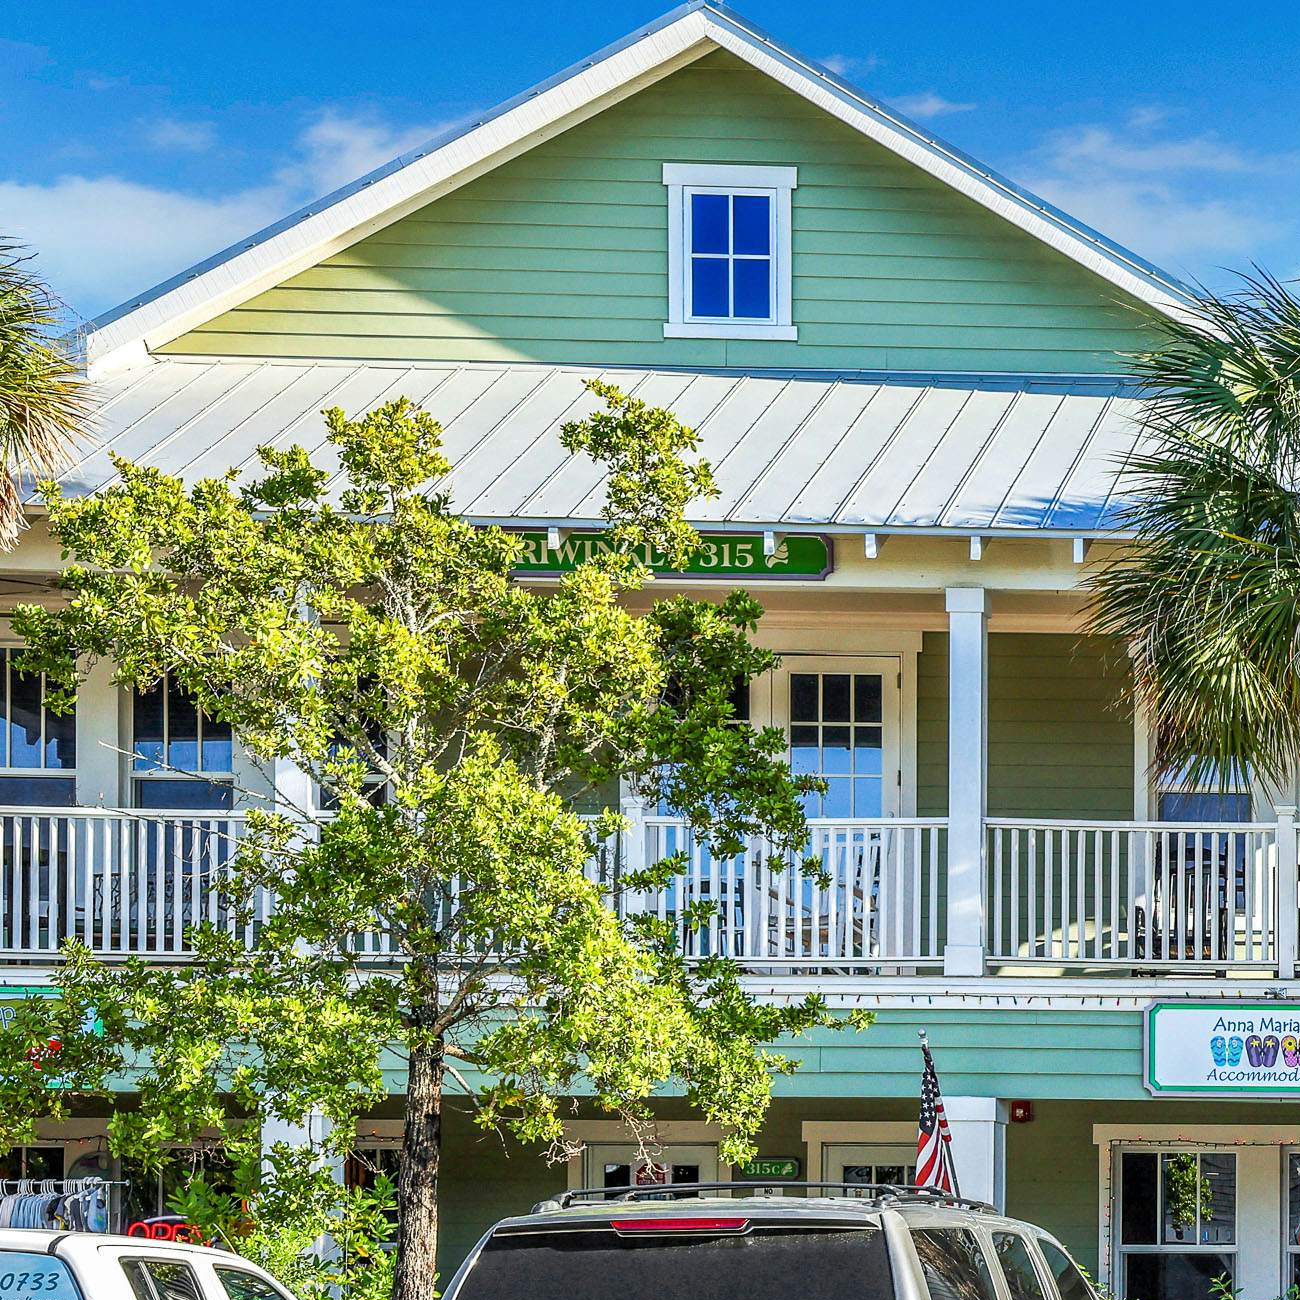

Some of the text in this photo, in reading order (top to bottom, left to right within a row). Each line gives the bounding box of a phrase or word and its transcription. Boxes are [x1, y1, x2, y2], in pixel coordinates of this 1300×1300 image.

[699, 543, 754, 568] 315
[1212, 1016, 1254, 1033] Anna
[1259, 1017, 1300, 1033] Maria
[764, 1187, 774, 1195] NO
